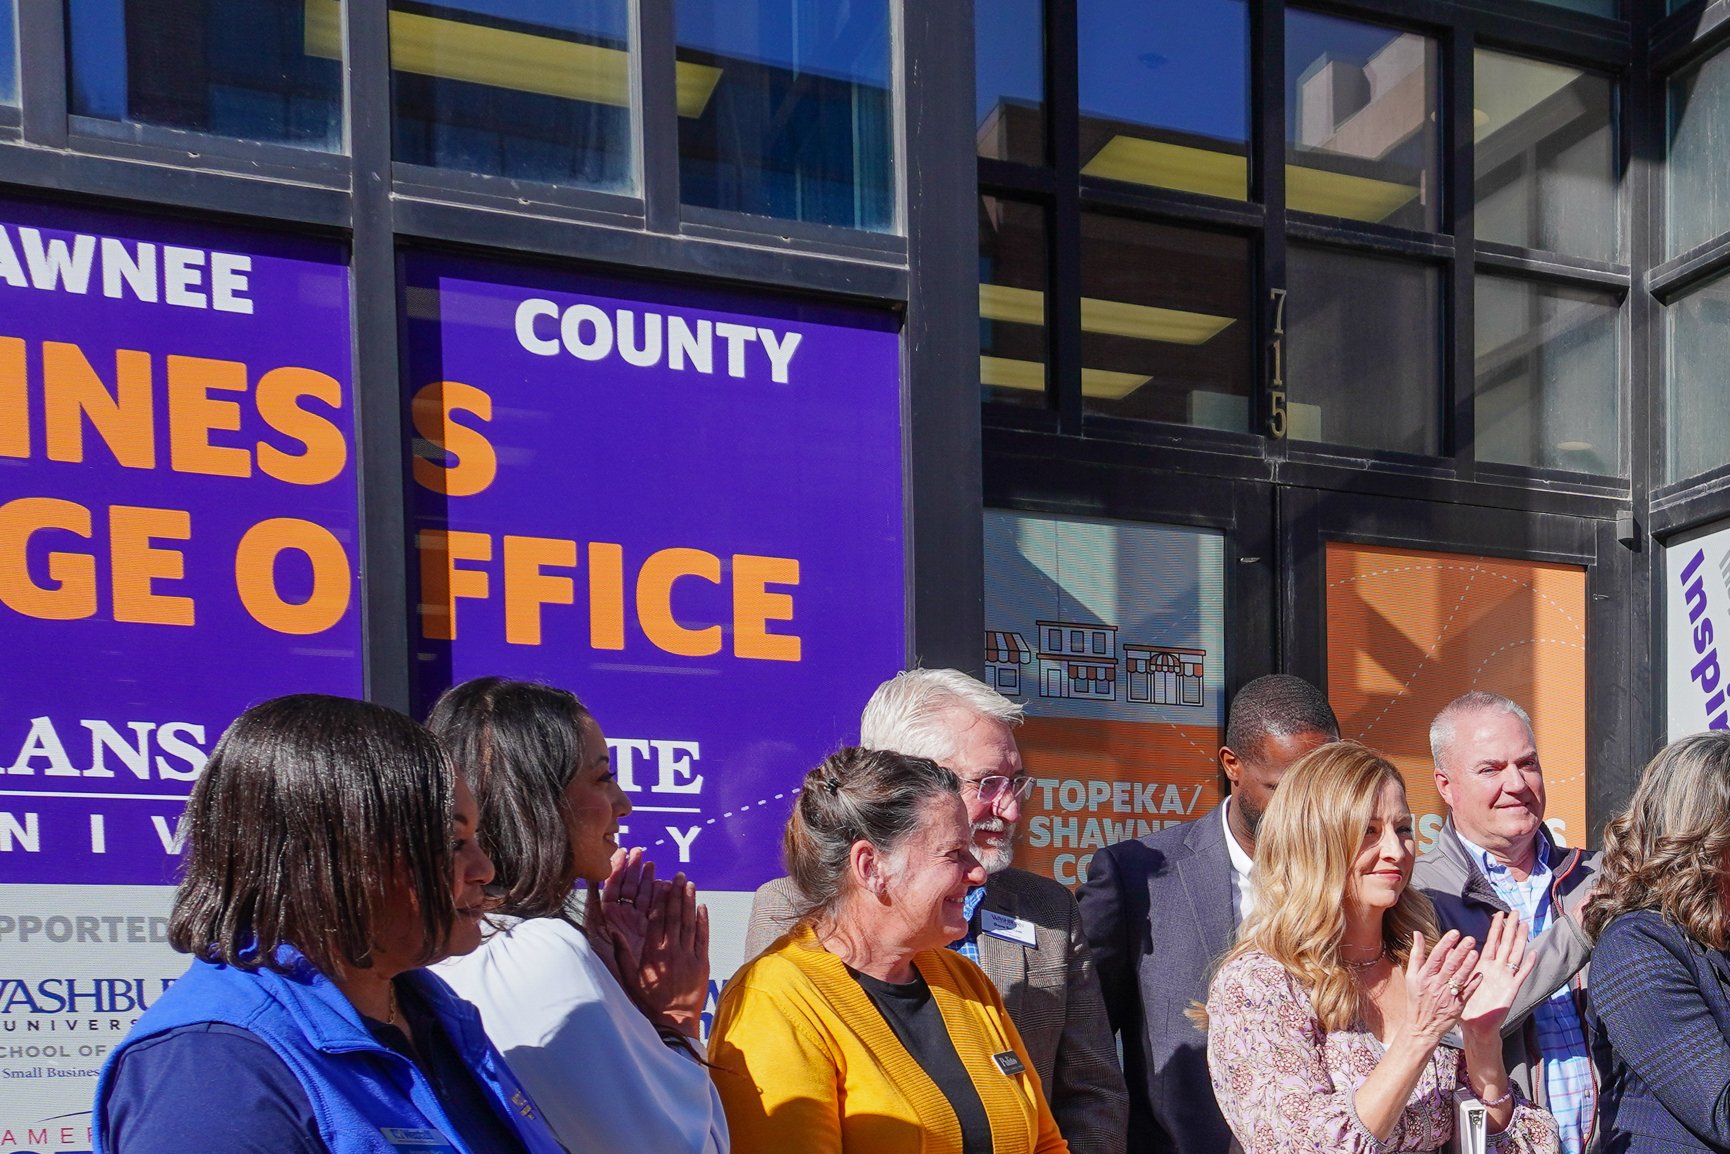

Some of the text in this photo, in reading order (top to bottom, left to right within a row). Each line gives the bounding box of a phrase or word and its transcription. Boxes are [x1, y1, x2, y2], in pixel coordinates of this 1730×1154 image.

[515, 298, 802, 384] COUNTY
[1036, 779, 1203, 815] TOPEKA/
[79, 1045, 106, 1057] OF
[3, 1067, 100, 1079] Small Busines
